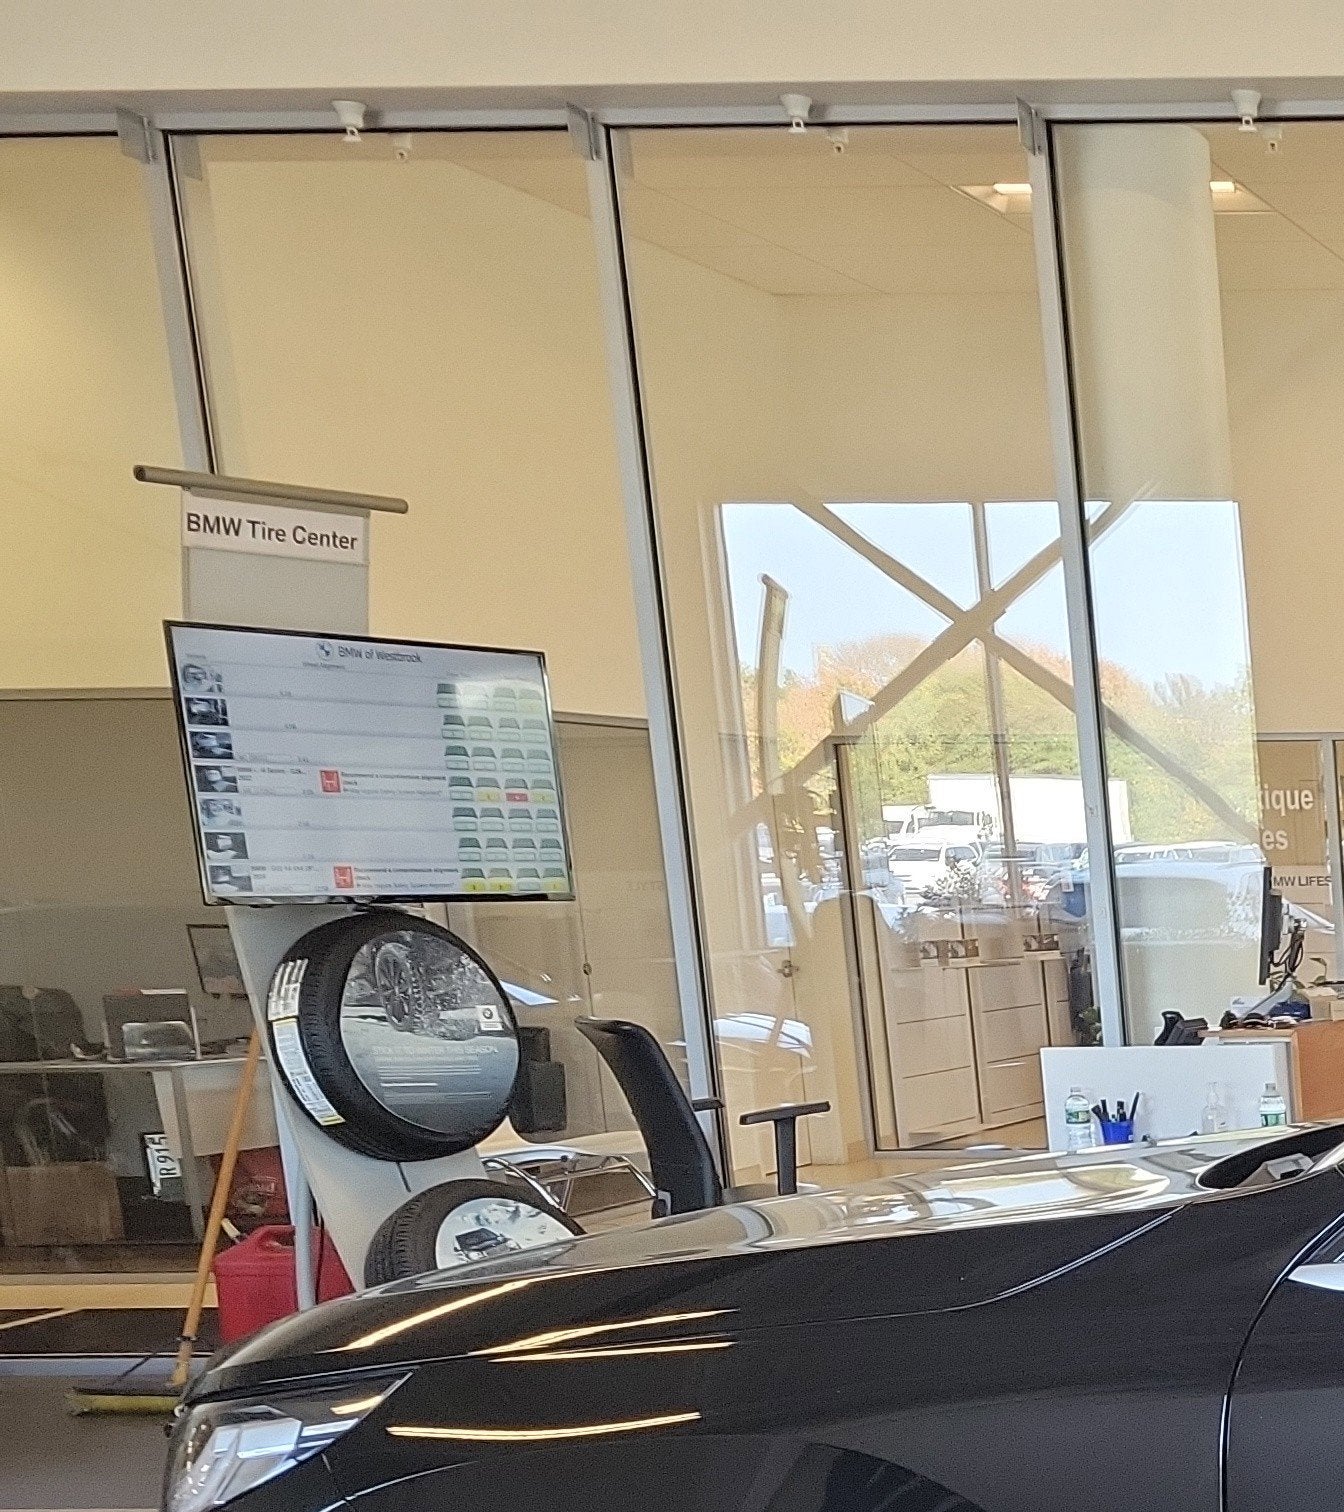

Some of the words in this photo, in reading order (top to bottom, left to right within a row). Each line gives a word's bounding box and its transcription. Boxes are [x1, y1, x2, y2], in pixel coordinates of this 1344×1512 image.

[186, 513, 242, 537] BMW
[246, 519, 287, 543] Tire
[292, 525, 358, 550] Center
